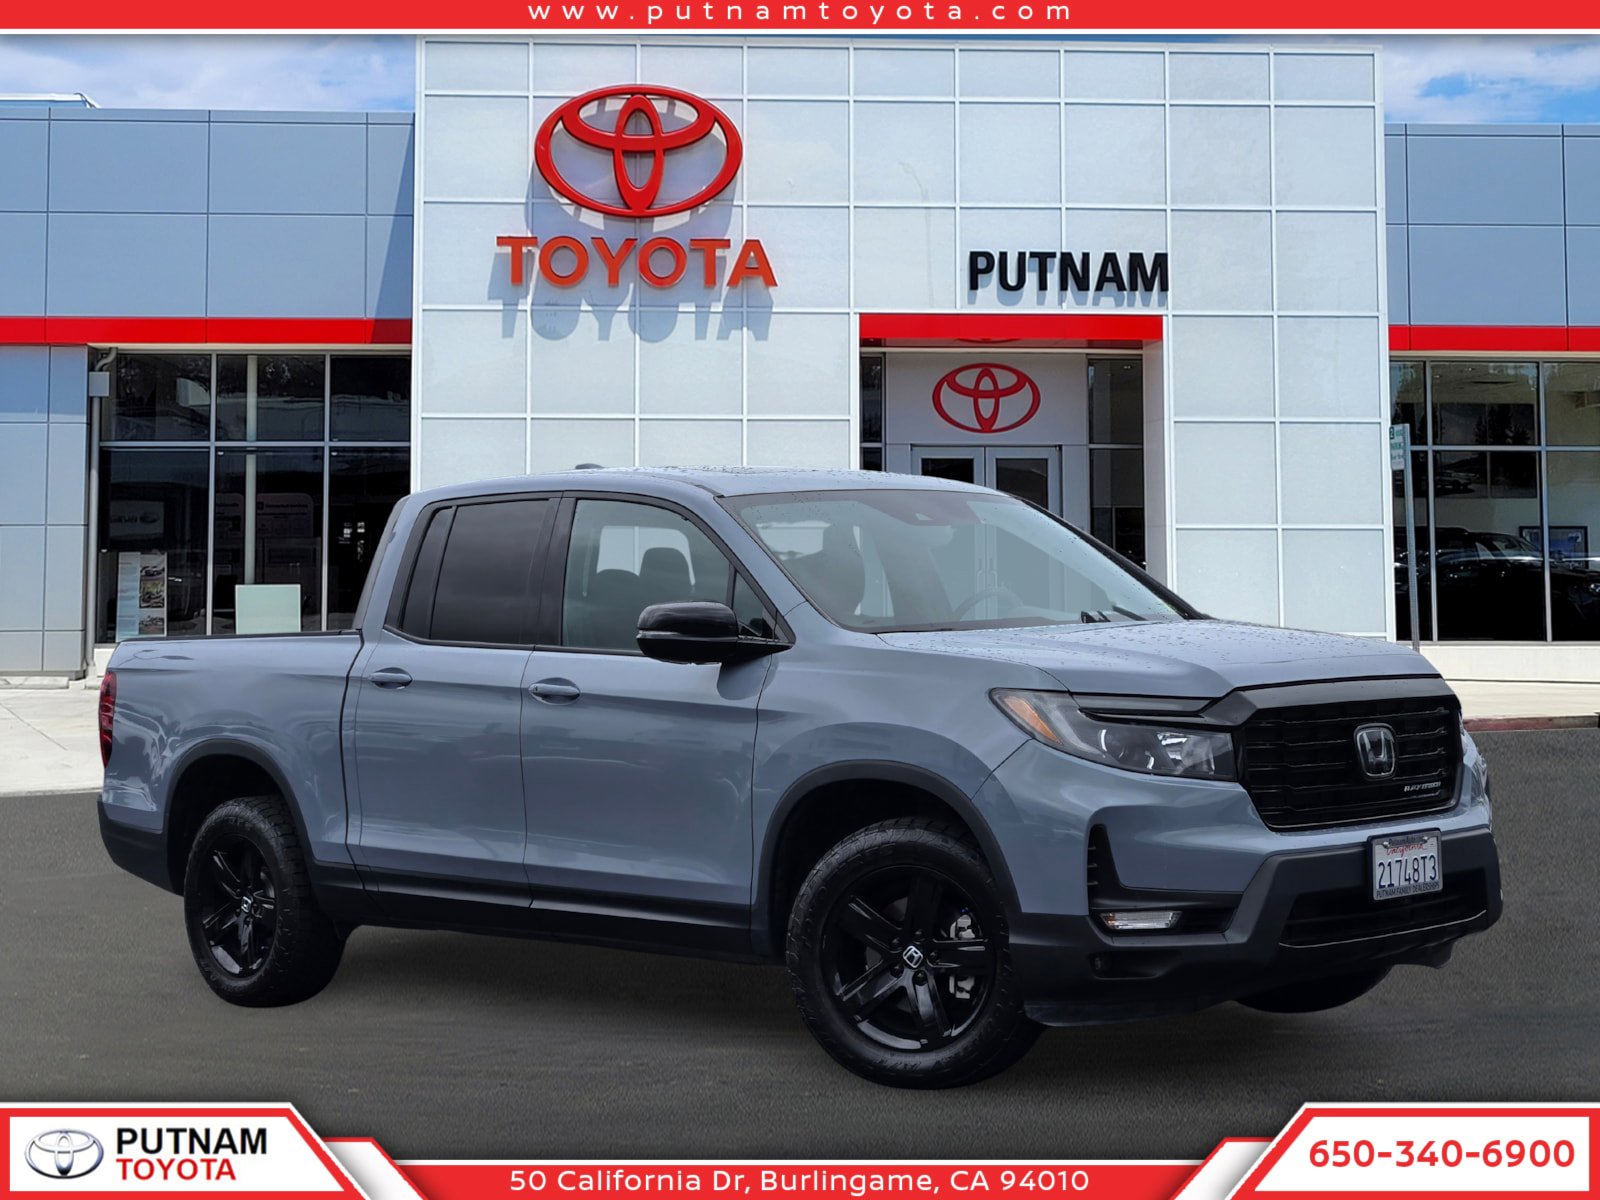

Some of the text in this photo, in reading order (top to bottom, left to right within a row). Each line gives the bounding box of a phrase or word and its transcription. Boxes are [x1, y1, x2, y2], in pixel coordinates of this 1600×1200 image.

[496, 236, 778, 288] TOYOTA
[969, 251, 1169, 292] PUTNAM
[1378, 854, 1437, 889] 21748T3
